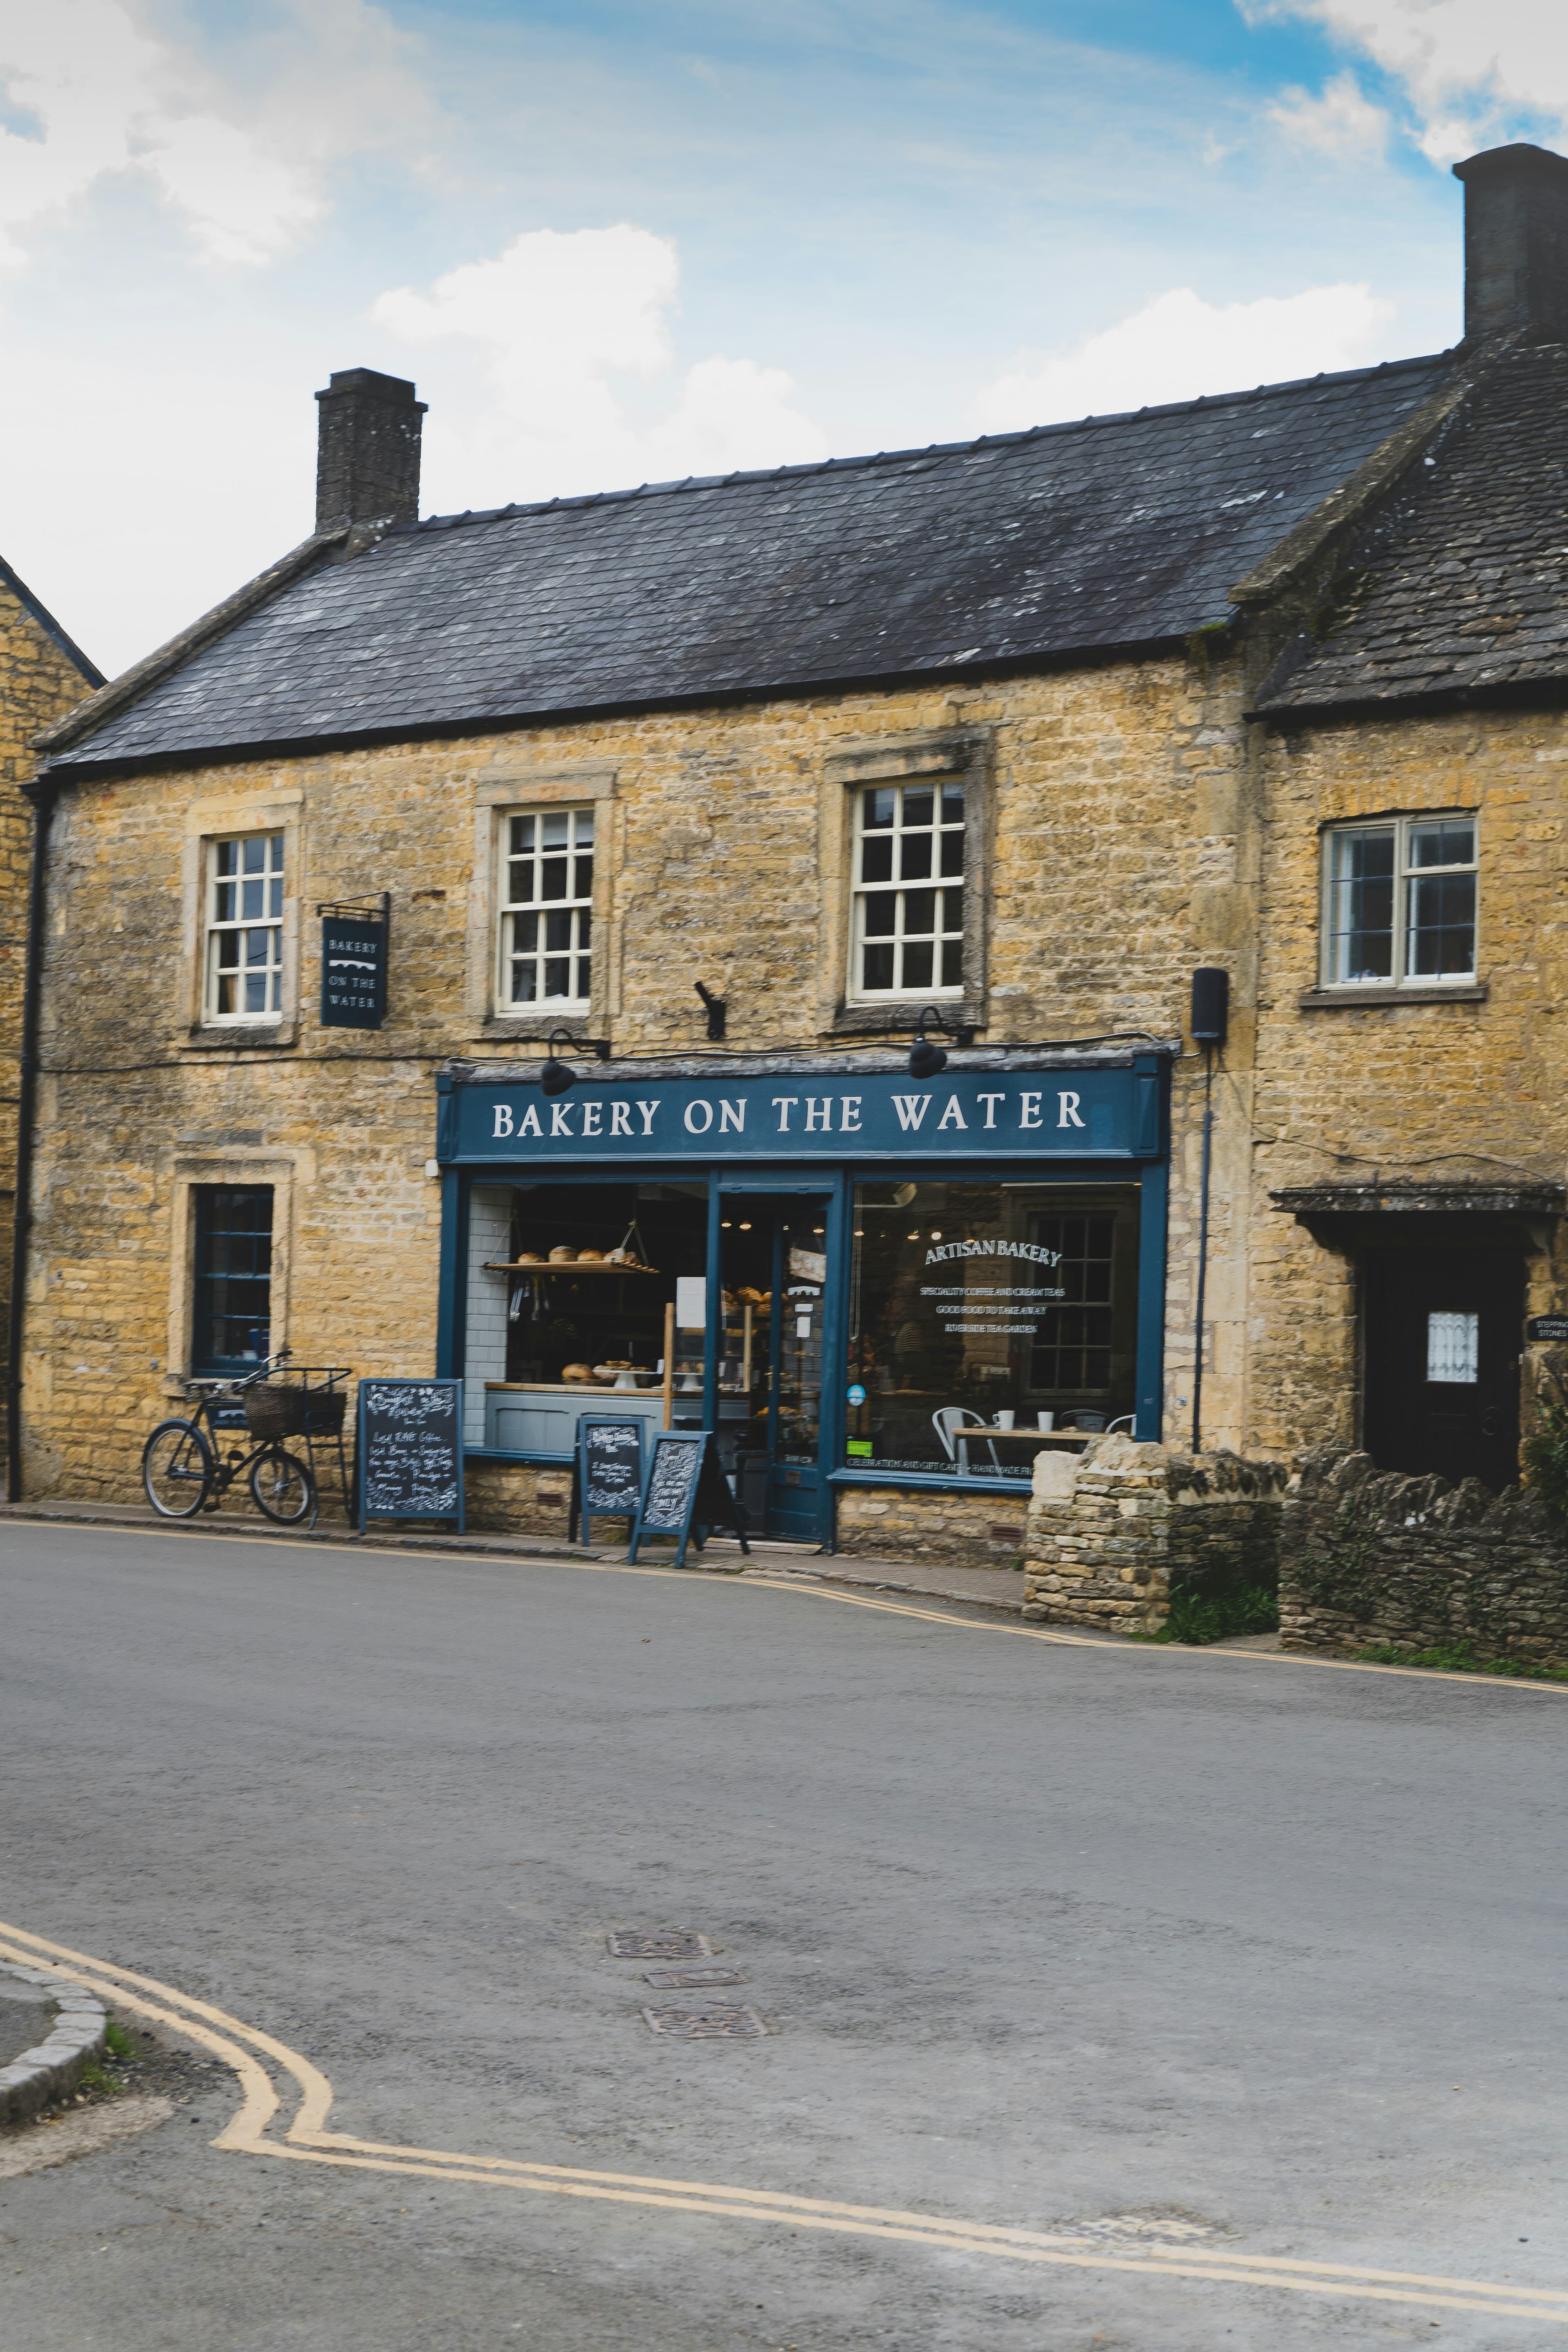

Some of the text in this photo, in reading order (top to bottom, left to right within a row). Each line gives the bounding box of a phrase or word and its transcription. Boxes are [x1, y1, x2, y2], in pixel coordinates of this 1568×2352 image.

[329, 940, 377, 953] BAKERY
[329, 976, 376, 989] ON THE
[329, 995, 375, 1008] WATER
[492, 1091, 1086, 1137] BAKERY ON THE WATER
[925, 1240, 1062, 1267] ARTISAN BAKERY
[964, 1287, 995, 1296] COFFEE
[994, 1287, 1013, 1296] AND
[1013, 1288, 1043, 1296] CREAM
[1043, 1288, 1066, 1296] TEAS
[936, 1305, 962, 1314] GOOD
[961, 1306, 985, 1314] FOOD
[985, 1306, 998, 1314] TO
[998, 1306, 1020, 1314] TAKE
[945, 1324, 1038, 1333] RIVERSIDE TEA GARDEN
